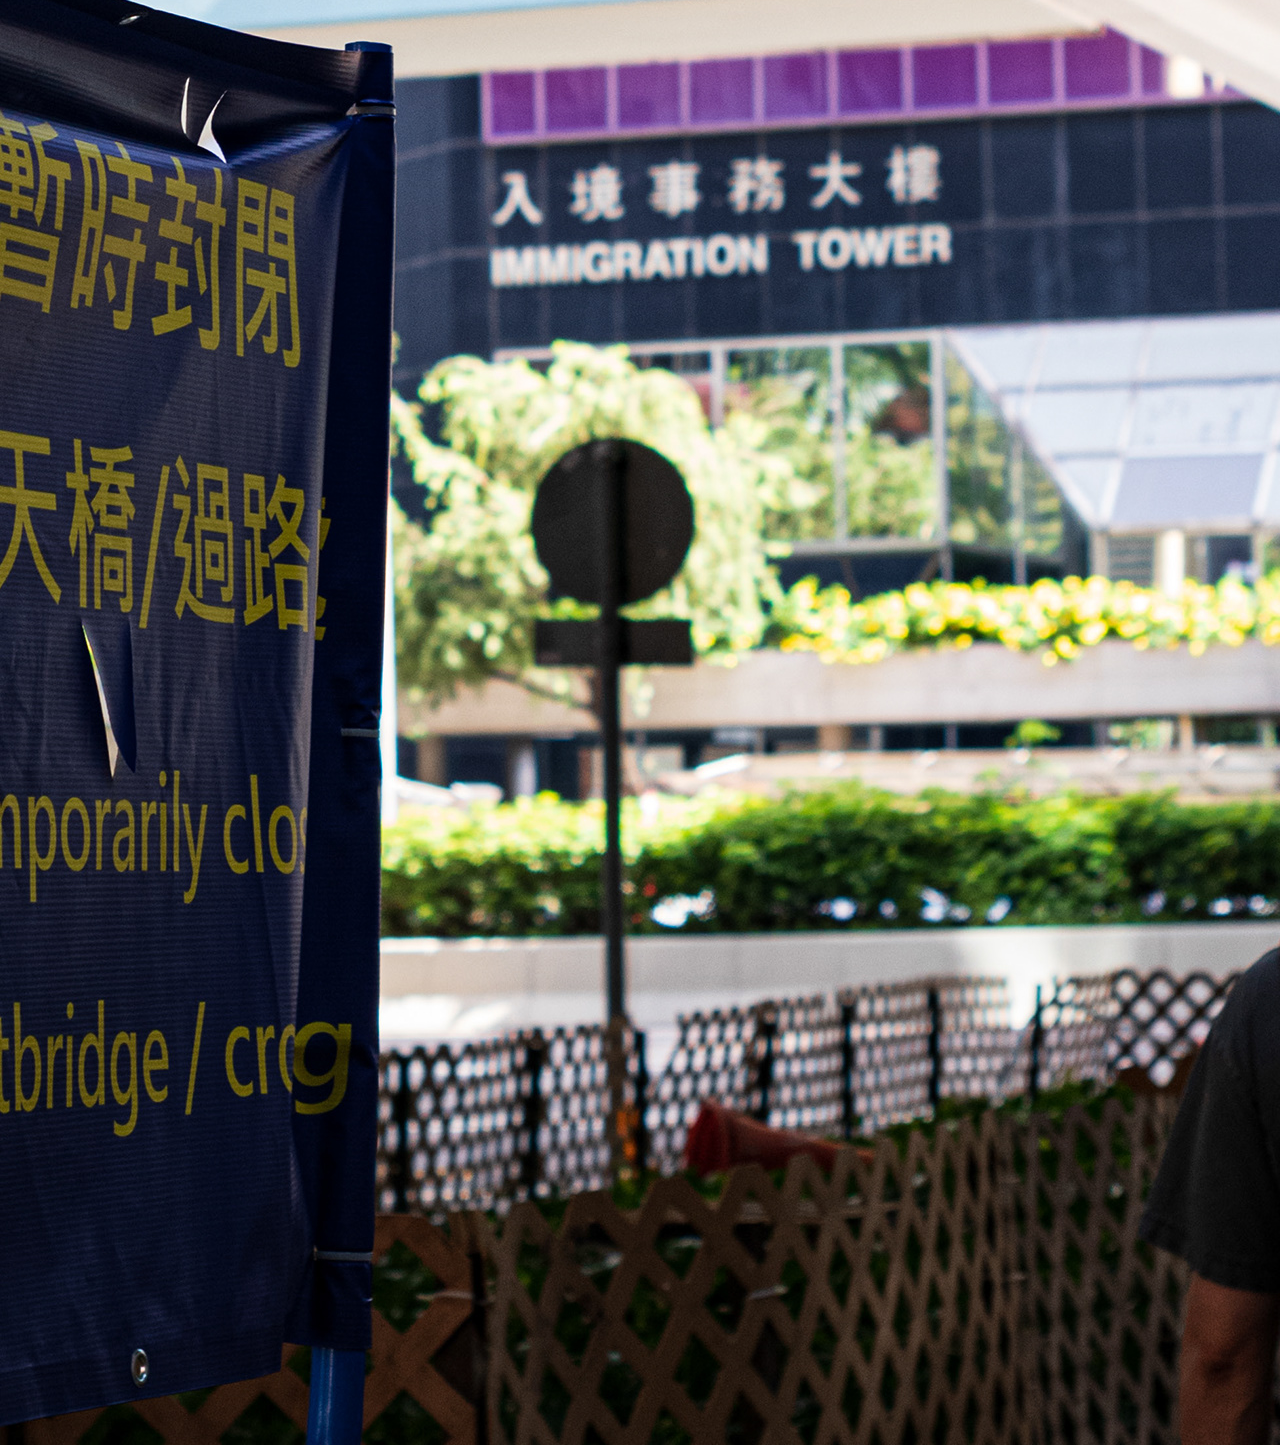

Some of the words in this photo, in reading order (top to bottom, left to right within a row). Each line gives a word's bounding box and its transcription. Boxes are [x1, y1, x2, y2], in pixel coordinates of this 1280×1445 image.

[492, 145, 941, 226] 入境事務大樓
[490, 234, 768, 287] IMMIGRATION
[792, 224, 952, 271] TOWER
[223, 775, 308, 875] clo
[185, 1002, 206, 1116] /
